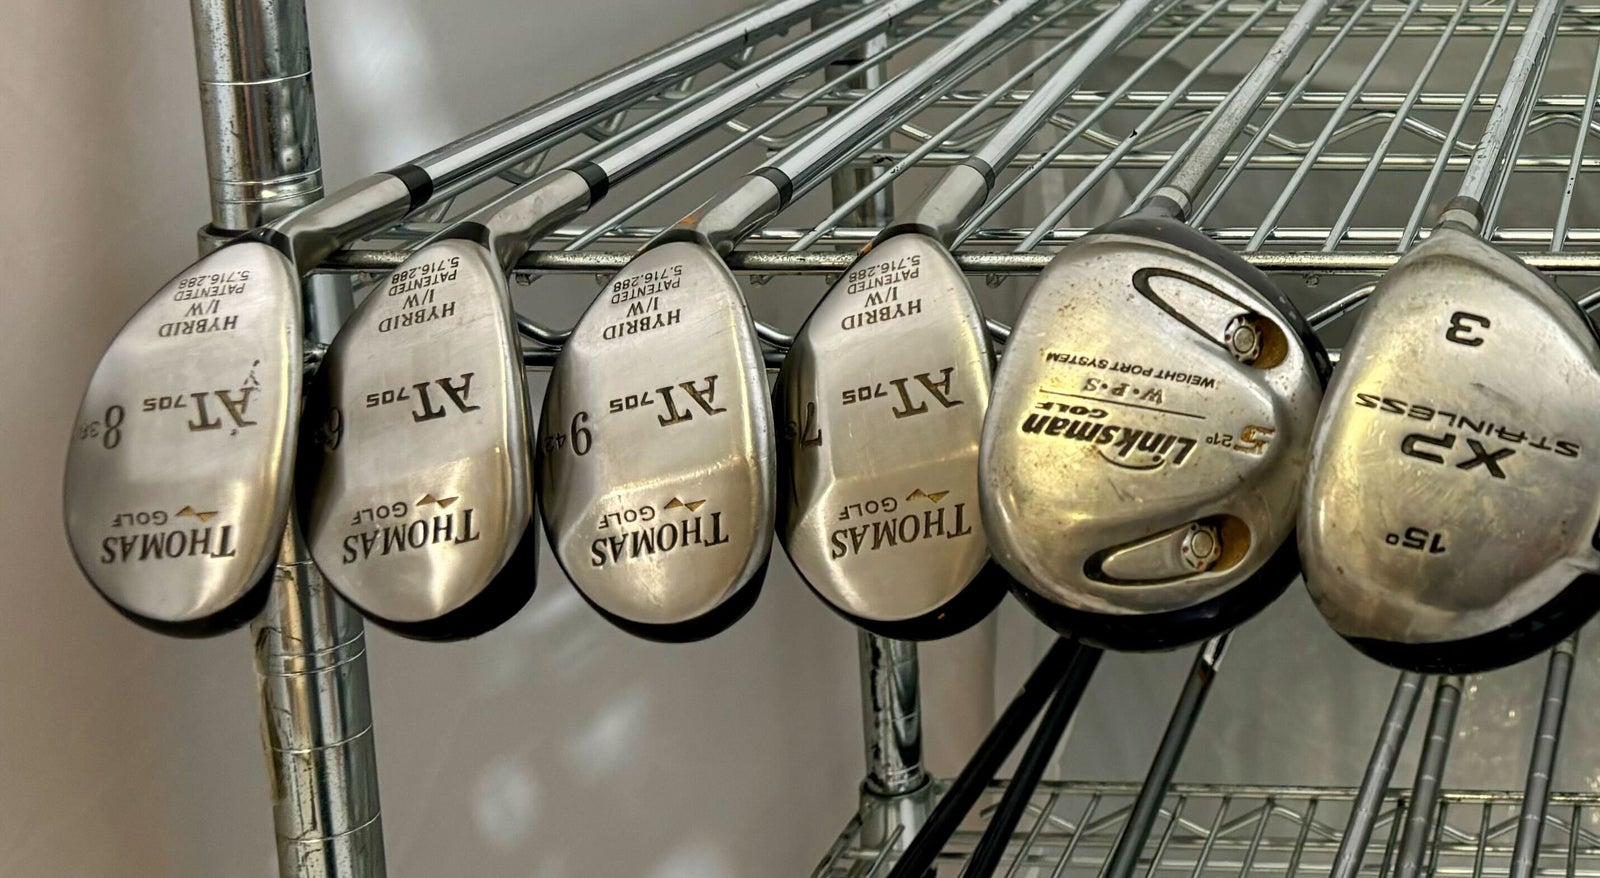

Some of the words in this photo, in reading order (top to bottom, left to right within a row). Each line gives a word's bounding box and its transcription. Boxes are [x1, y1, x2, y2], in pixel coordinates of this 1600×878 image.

[178, 269, 251, 290] 5.716.288
[388, 269, 458, 296] PATENTED
[391, 255, 460, 284] 5.716.288
[613, 264, 683, 293] 5.716.288
[847, 266, 920, 295] PATENTED
[848, 254, 921, 283] 5.716.288
[173, 282, 247, 302] PATENTED
[402, 288, 435, 310] I/W
[611, 277, 681, 304] PATENTED
[864, 286, 899, 308] I/W
[185, 300, 220, 317] I/W
[377, 301, 456, 333] HYBRID
[626, 296, 659, 318] I/W
[841, 297, 922, 331] HYBRID
[158, 314, 238, 338] HYBRID
[603, 308, 681, 341] HYBRID
[1446, 311, 1491, 347] 3
[1046, 351, 1109, 372] SYSTEM
[1111, 361, 1153, 381] PORT
[1153, 369, 1217, 390] WEIGHT
[1035, 401, 1109, 419] GOLF
[103, 404, 126, 450] 8
[570, 411, 593, 457] 9
[800, 402, 823, 448] 7
[1355, 392, 1581, 458] STAINLESS
[1021, 412, 1198, 469] Linksman
[1233, 424, 1276, 456] 5
[1401, 432, 1516, 480] XP
[111, 510, 168, 528] GOLF
[351, 501, 408, 525] GOLF
[599, 504, 656, 529] GOLF
[838, 496, 898, 521] GOLF
[101, 524, 236, 565] THOMAS
[343, 509, 480, 565] THOMAS
[591, 511, 729, 568] THOMAS
[831, 503, 972, 561] THOMAS
